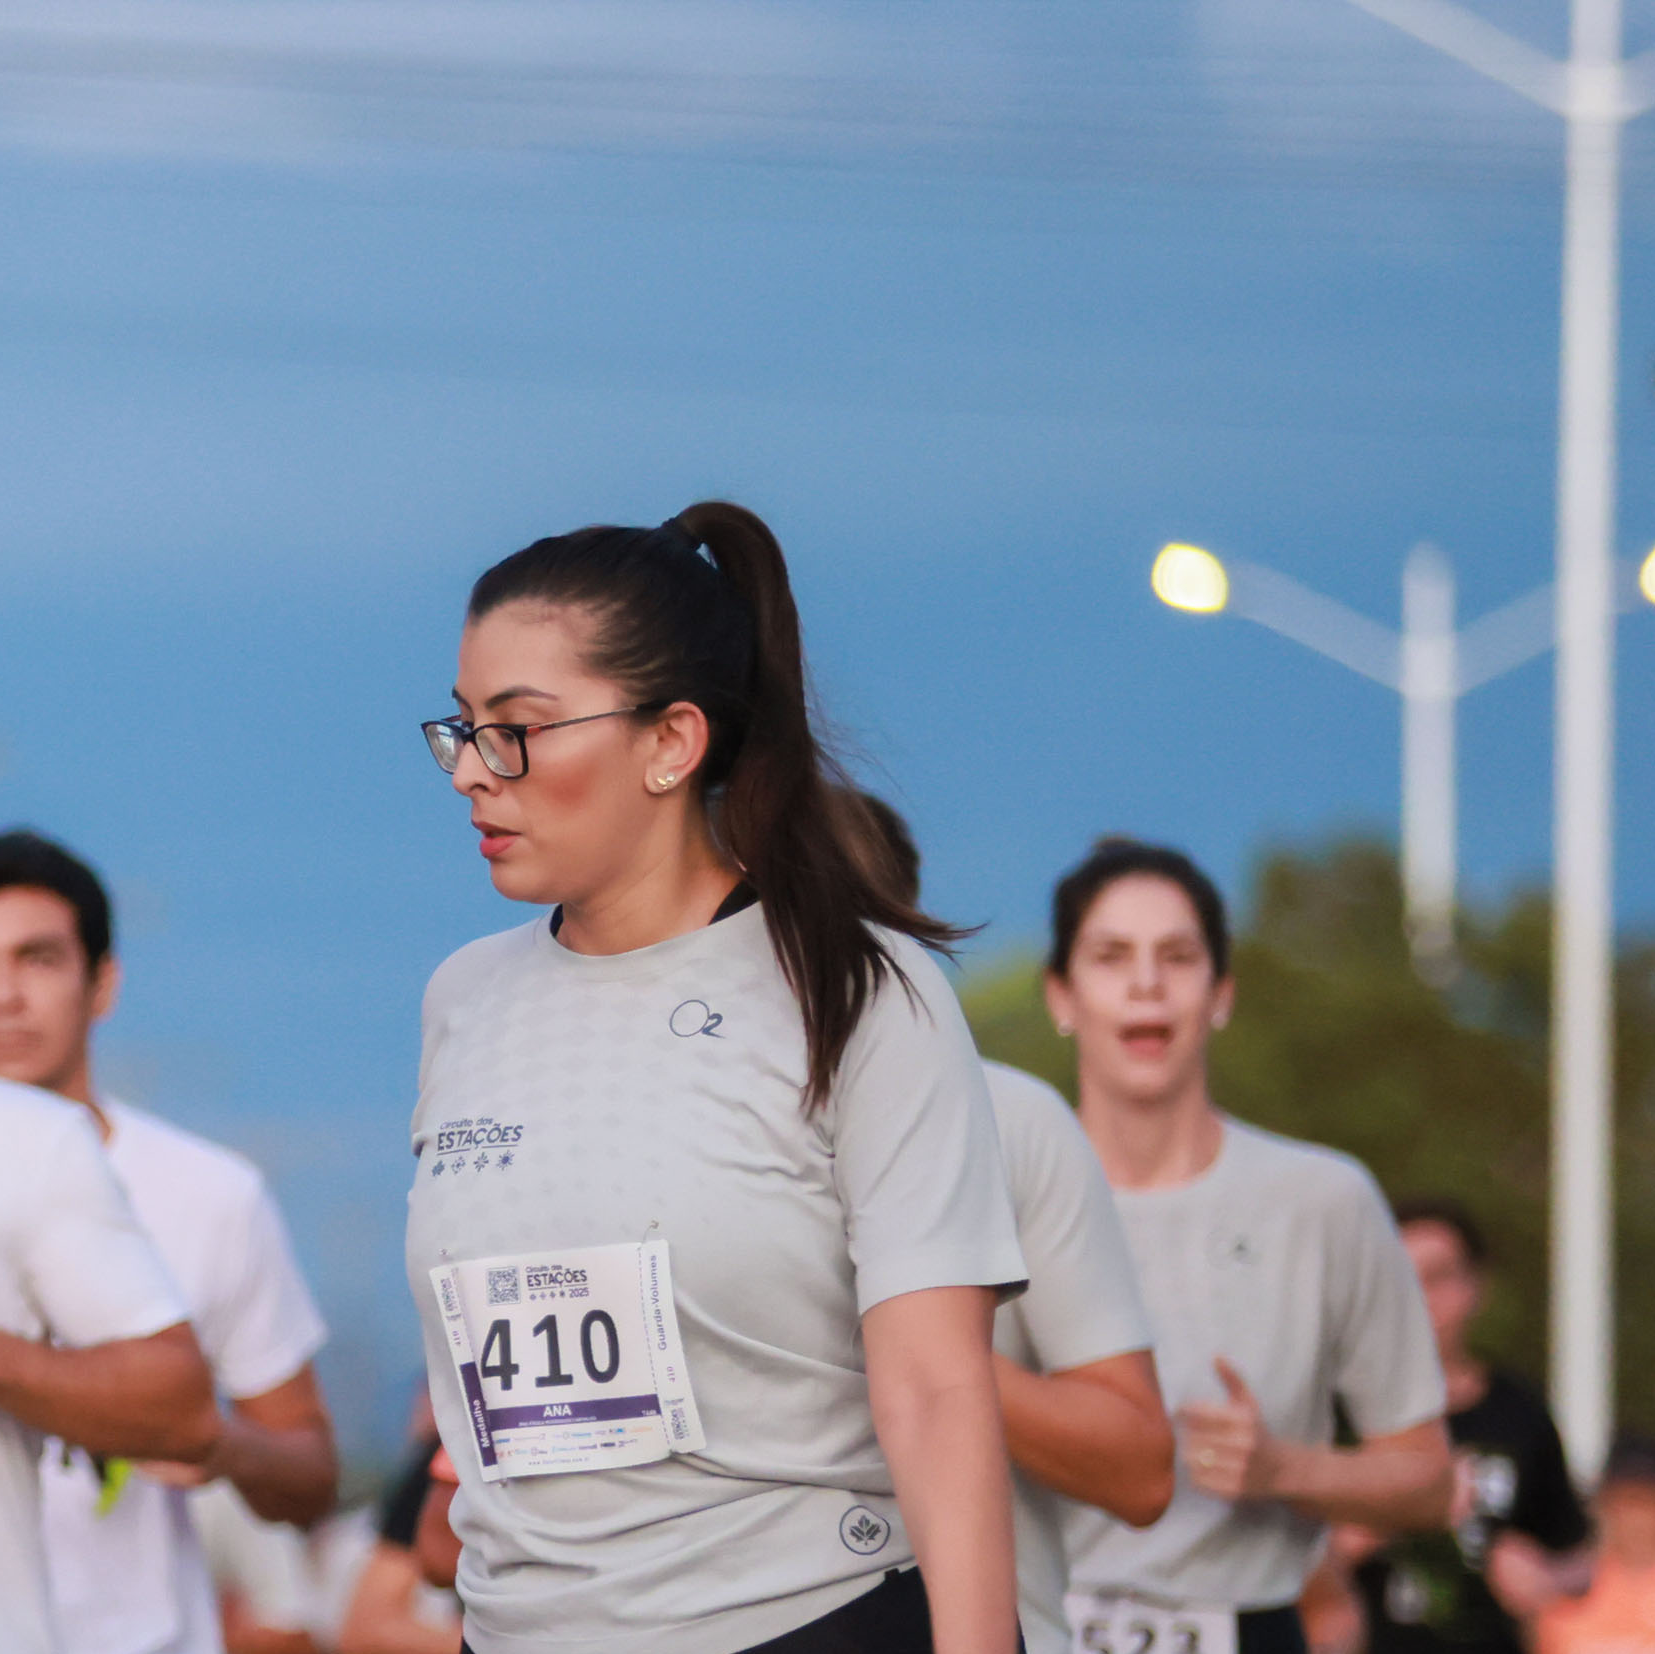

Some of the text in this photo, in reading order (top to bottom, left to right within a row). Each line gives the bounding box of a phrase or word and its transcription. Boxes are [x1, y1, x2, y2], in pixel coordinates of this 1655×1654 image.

[437, 1123, 523, 1150] ESTAÇÕES
[527, 1268, 588, 1288] ESTAÇÕES
[568, 1288, 590, 1299] 2025
[650, 1255, 667, 1351] Guarda-Volumes
[480, 1309, 621, 1391] 410
[472, 1398, 491, 1448] Medalha
[543, 1404, 572, 1418] ANA
